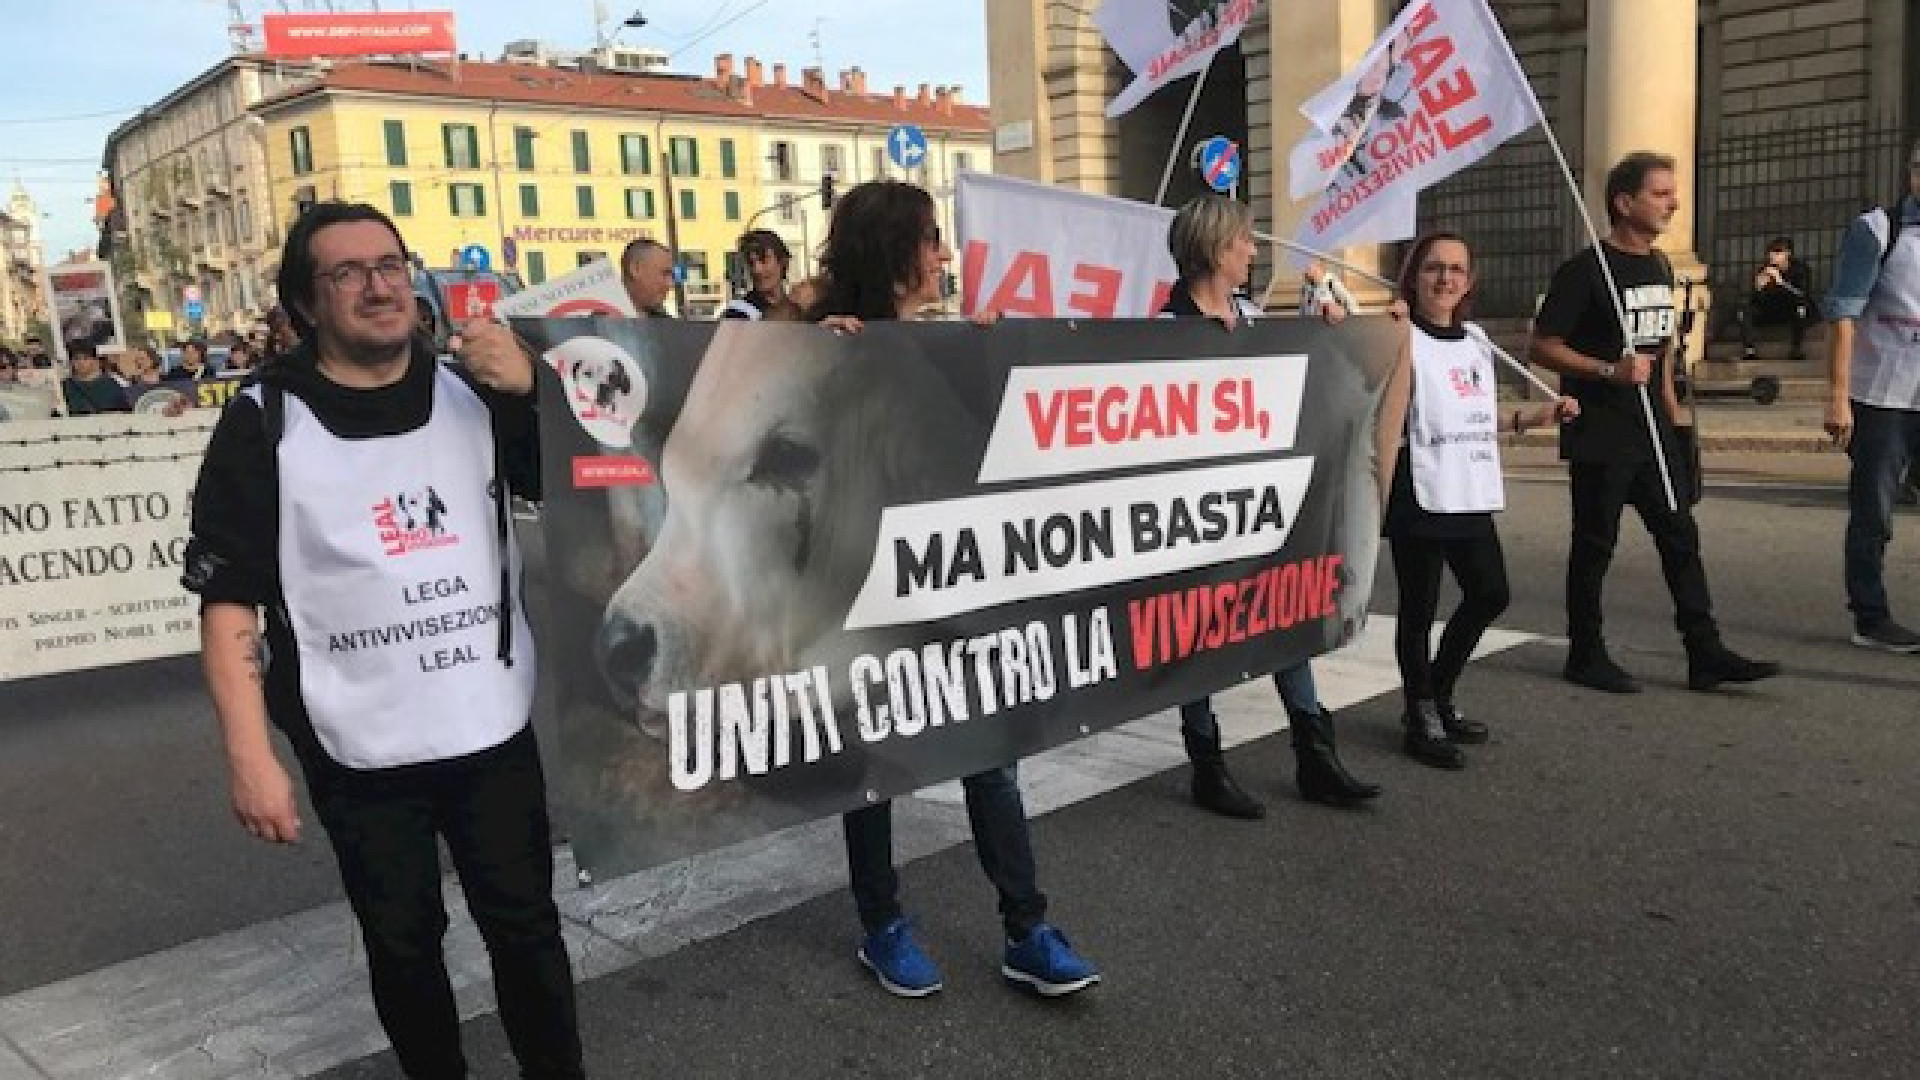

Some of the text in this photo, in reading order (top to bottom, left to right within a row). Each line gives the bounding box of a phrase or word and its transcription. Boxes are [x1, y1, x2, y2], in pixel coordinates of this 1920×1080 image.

[514, 225, 603, 242] Mercure
[1026, 378, 1270, 450] VEGAN SI,
[63, 491, 168, 528] FATTO
[372, 497, 407, 555] LEAL
[894, 485, 1284, 598] MA NON BASTA
[402, 575, 468, 605] LEGA
[329, 601, 503, 653] ANTIVIVISEZION
[420, 645, 480, 672] LEAL
[668, 555, 1344, 790] UNITI CONTRO LA VIVISEZIONE
